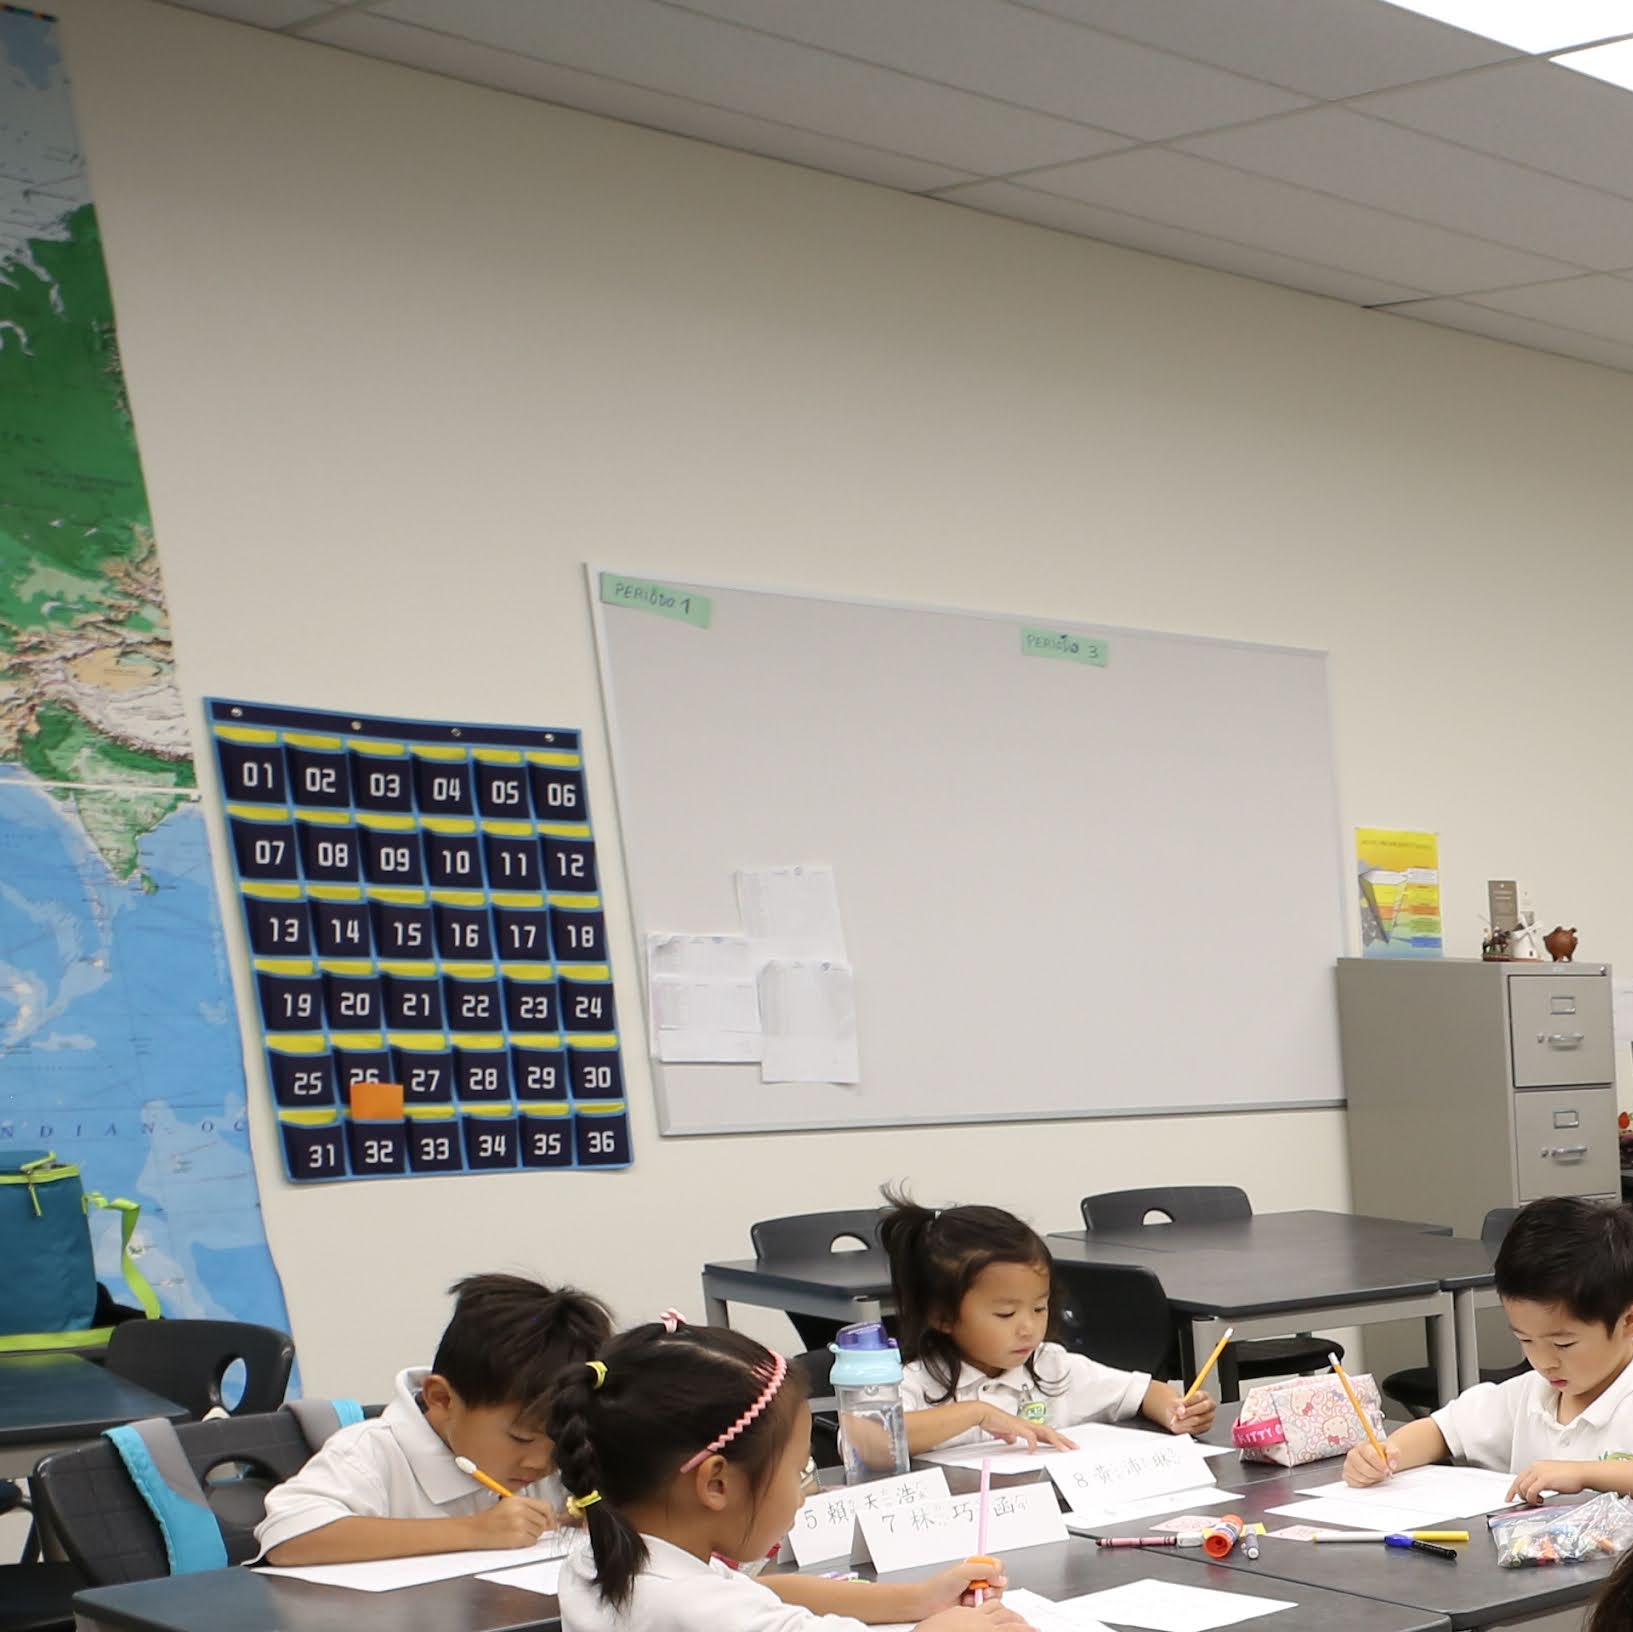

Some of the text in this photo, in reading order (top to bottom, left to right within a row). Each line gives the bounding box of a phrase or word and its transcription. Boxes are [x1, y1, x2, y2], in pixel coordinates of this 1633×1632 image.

[680, 597, 691, 615] 1
[1087, 644, 1099, 659] 3
[243, 761, 576, 807] 01 02 03 04 05 06
[255, 840, 585, 877] 07 08 09 10 11 12
[269, 917, 594, 948] 13 14 15 16 17 18
[283, 991, 603, 1019] 19 20 21 22 23 24
[293, 1072, 322, 1095] 25
[411, 1069, 440, 1092] 27
[469, 1068, 498, 1091] 28
[527, 1066, 556, 1090] 29
[583, 1066, 611, 1089] 30
[309, 1130, 615, 1168] 31 32 33 34 35 36
[1239, 1425, 1274, 1445] KITTY
[1072, 1472, 1089, 1489] 8
[803, 1509, 819, 1530] 5
[880, 1513, 897, 1534] 7
